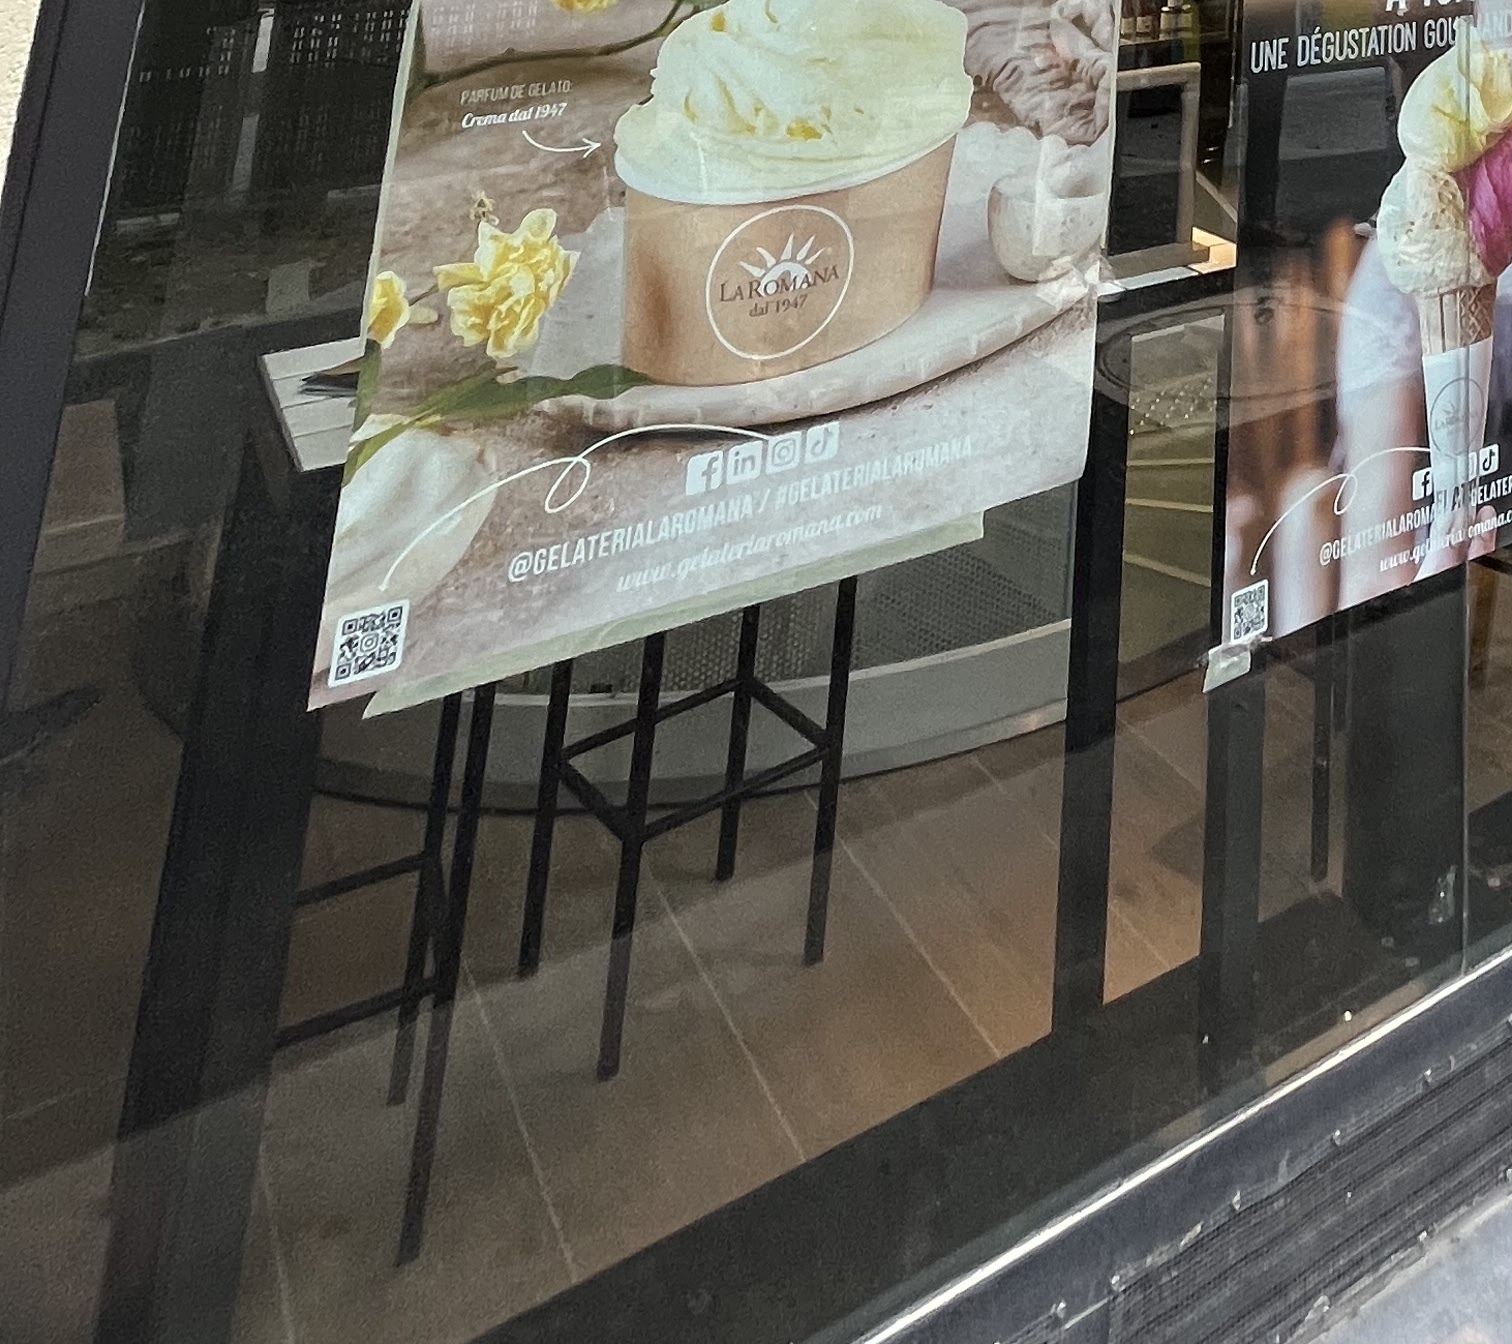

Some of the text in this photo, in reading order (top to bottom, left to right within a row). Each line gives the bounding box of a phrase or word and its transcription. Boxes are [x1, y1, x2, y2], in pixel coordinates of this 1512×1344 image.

[1249, 35, 1290, 75] UNE
[1296, 20, 1418, 69] DÉGUSTATION
[459, 85, 511, 107] PARFUM
[510, 83, 526, 100] DE
[461, 101, 569, 130] Crema dal 1947
[719, 263, 840, 303] LA ROMANA
[748, 292, 809, 318] dal 1947
[507, 496, 754, 584] @GELATERIALAROMANA
